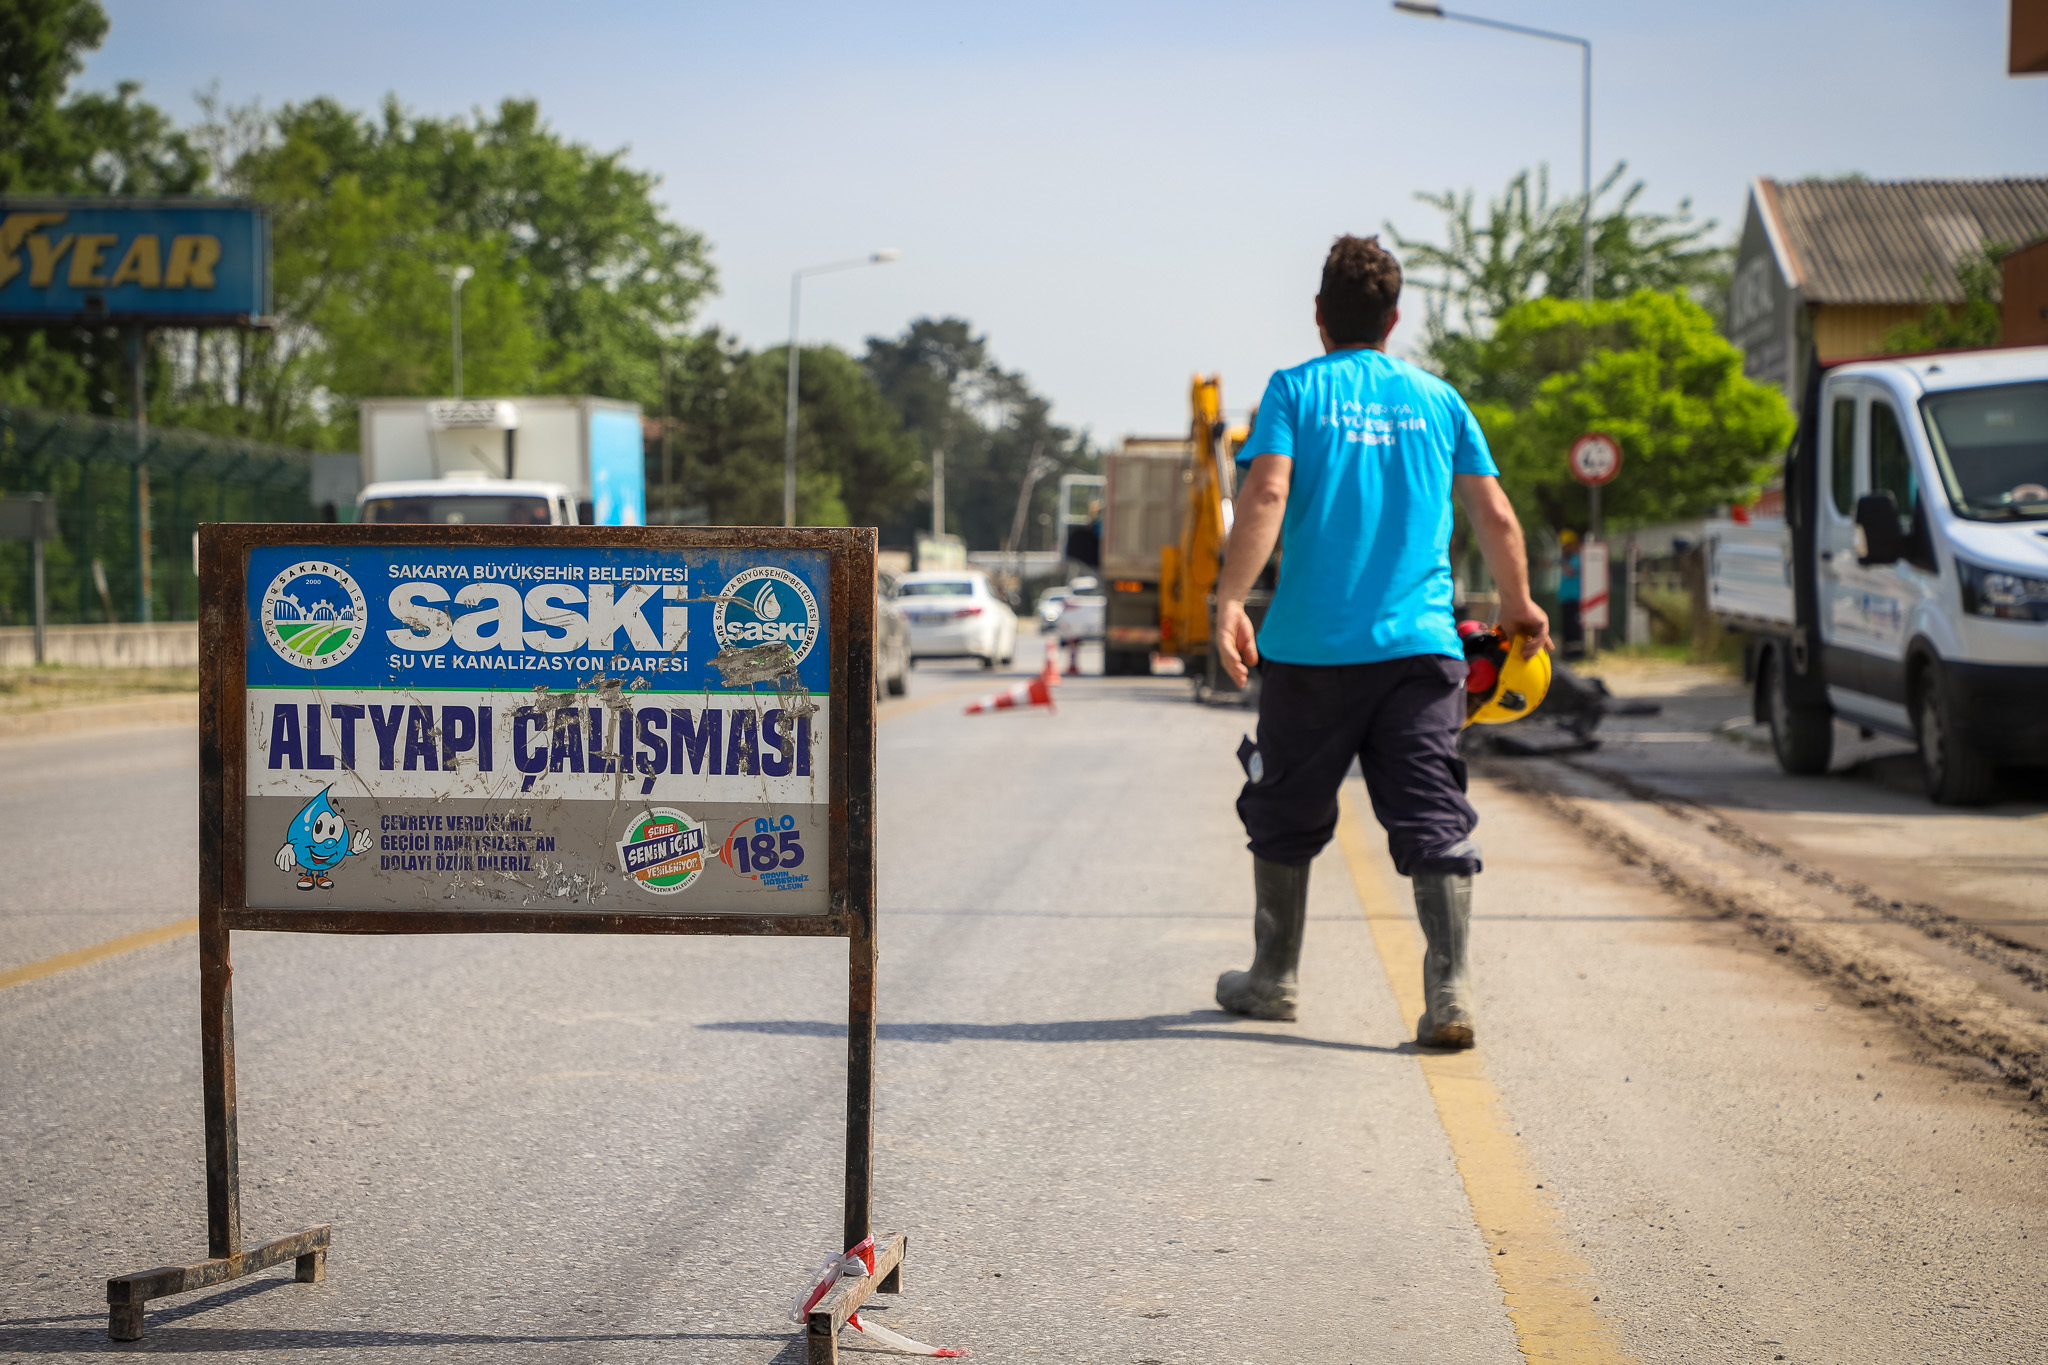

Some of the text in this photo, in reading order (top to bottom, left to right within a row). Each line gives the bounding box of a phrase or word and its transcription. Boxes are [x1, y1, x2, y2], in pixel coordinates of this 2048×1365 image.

[279, 564, 350, 585] SAKARYA
[388, 563, 689, 582] SAKARYA BÜYÜKŞEHİR BELEDİYESİ
[389, 654, 415, 669] SU
[420, 654, 446, 669] VE
[268, 703, 811, 795] ALTYAPI ÇALIŞMASI
[380, 814, 443, 833] ÇEVREYE
[755, 814, 795, 834] ALO
[380, 832, 430, 853] GEÇİCİ
[733, 830, 805, 873] 185
